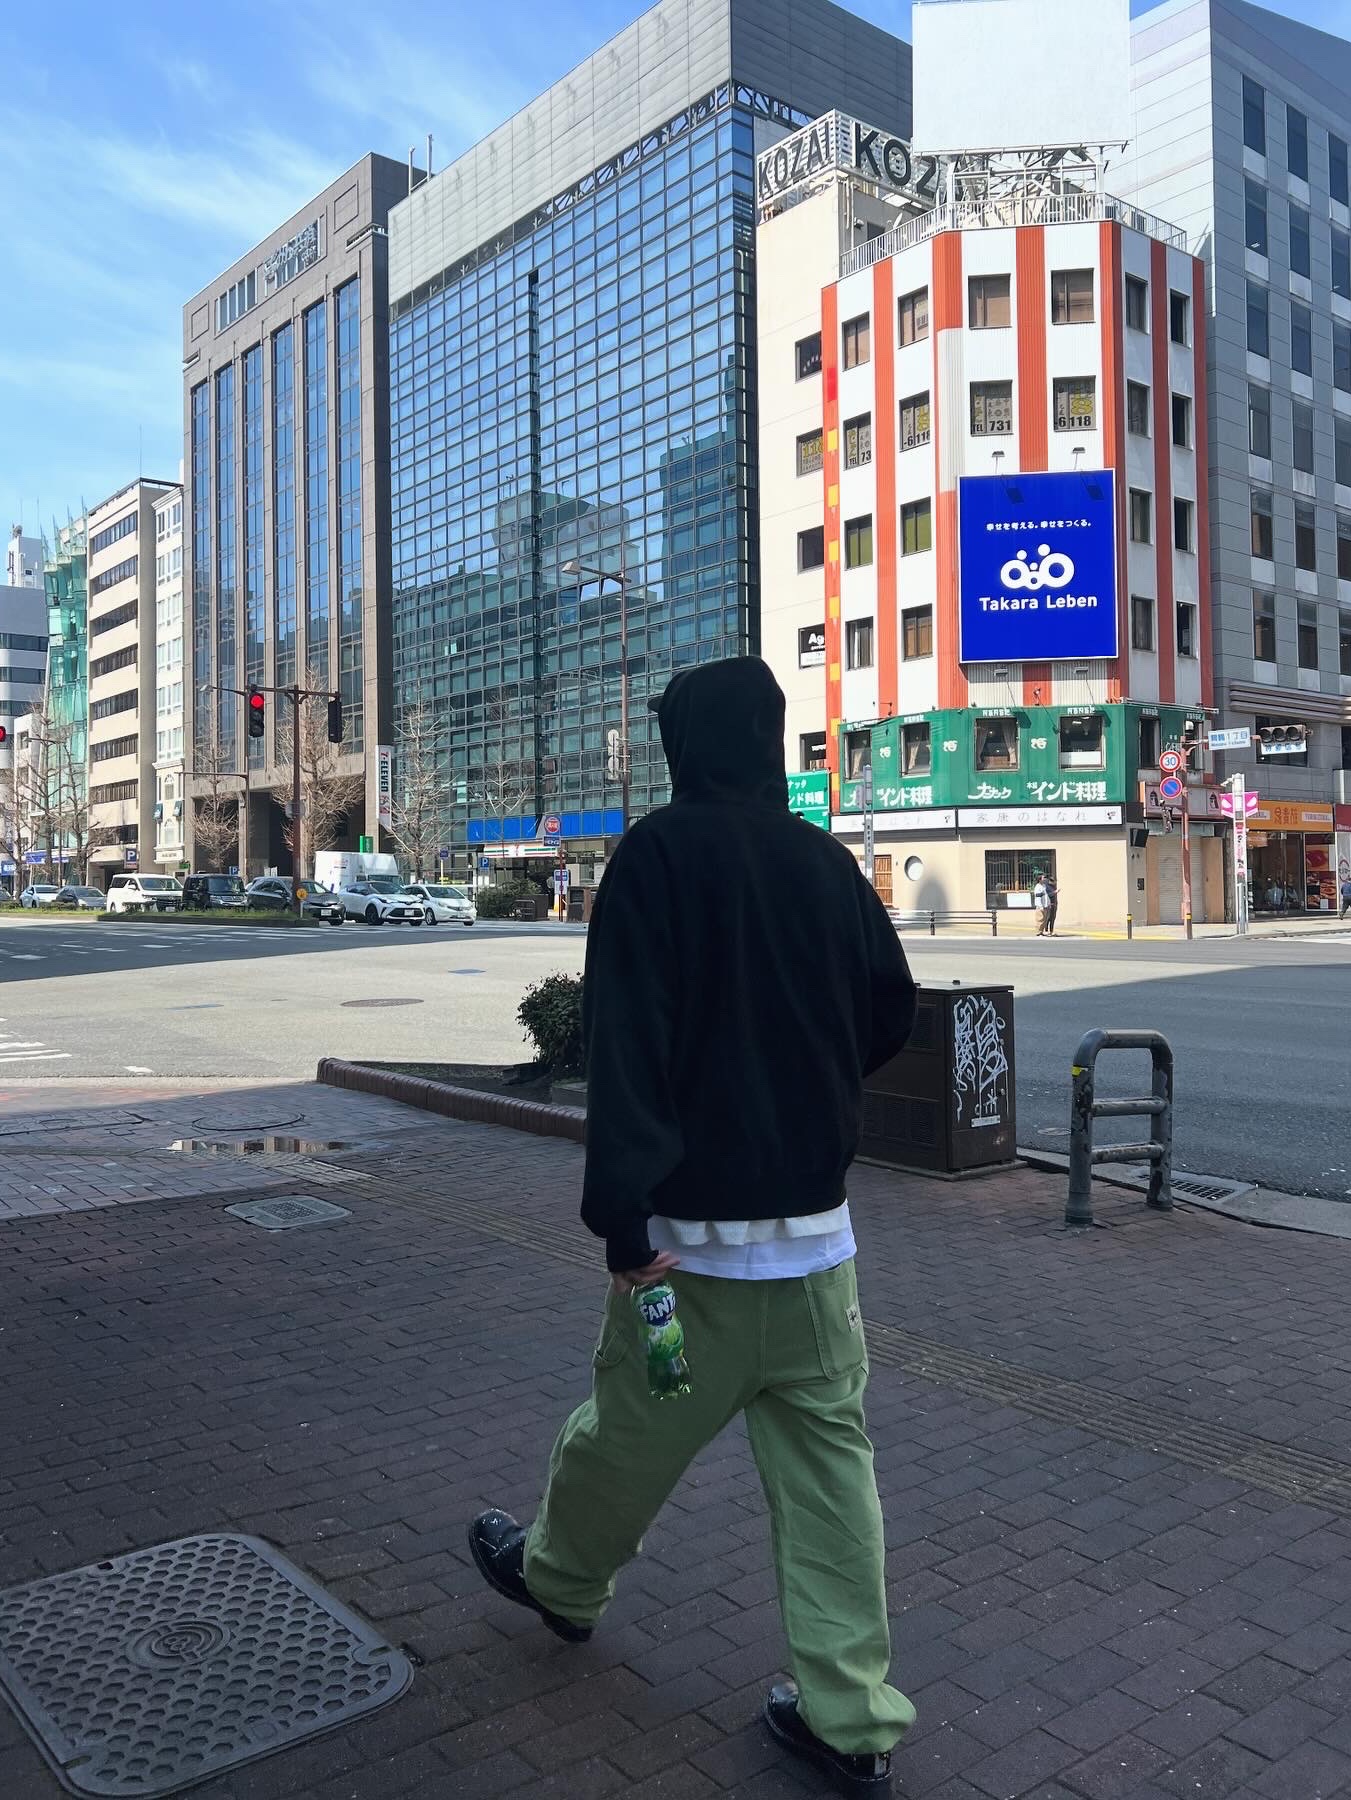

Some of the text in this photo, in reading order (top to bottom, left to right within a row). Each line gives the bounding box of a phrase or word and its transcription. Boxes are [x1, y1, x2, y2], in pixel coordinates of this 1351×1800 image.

[758, 120, 832, 200] KOZAI
[989, 420, 1011, 431] 731
[979, 594, 1098, 612] Takara Leben
[1164, 756, 1177, 766] 30
